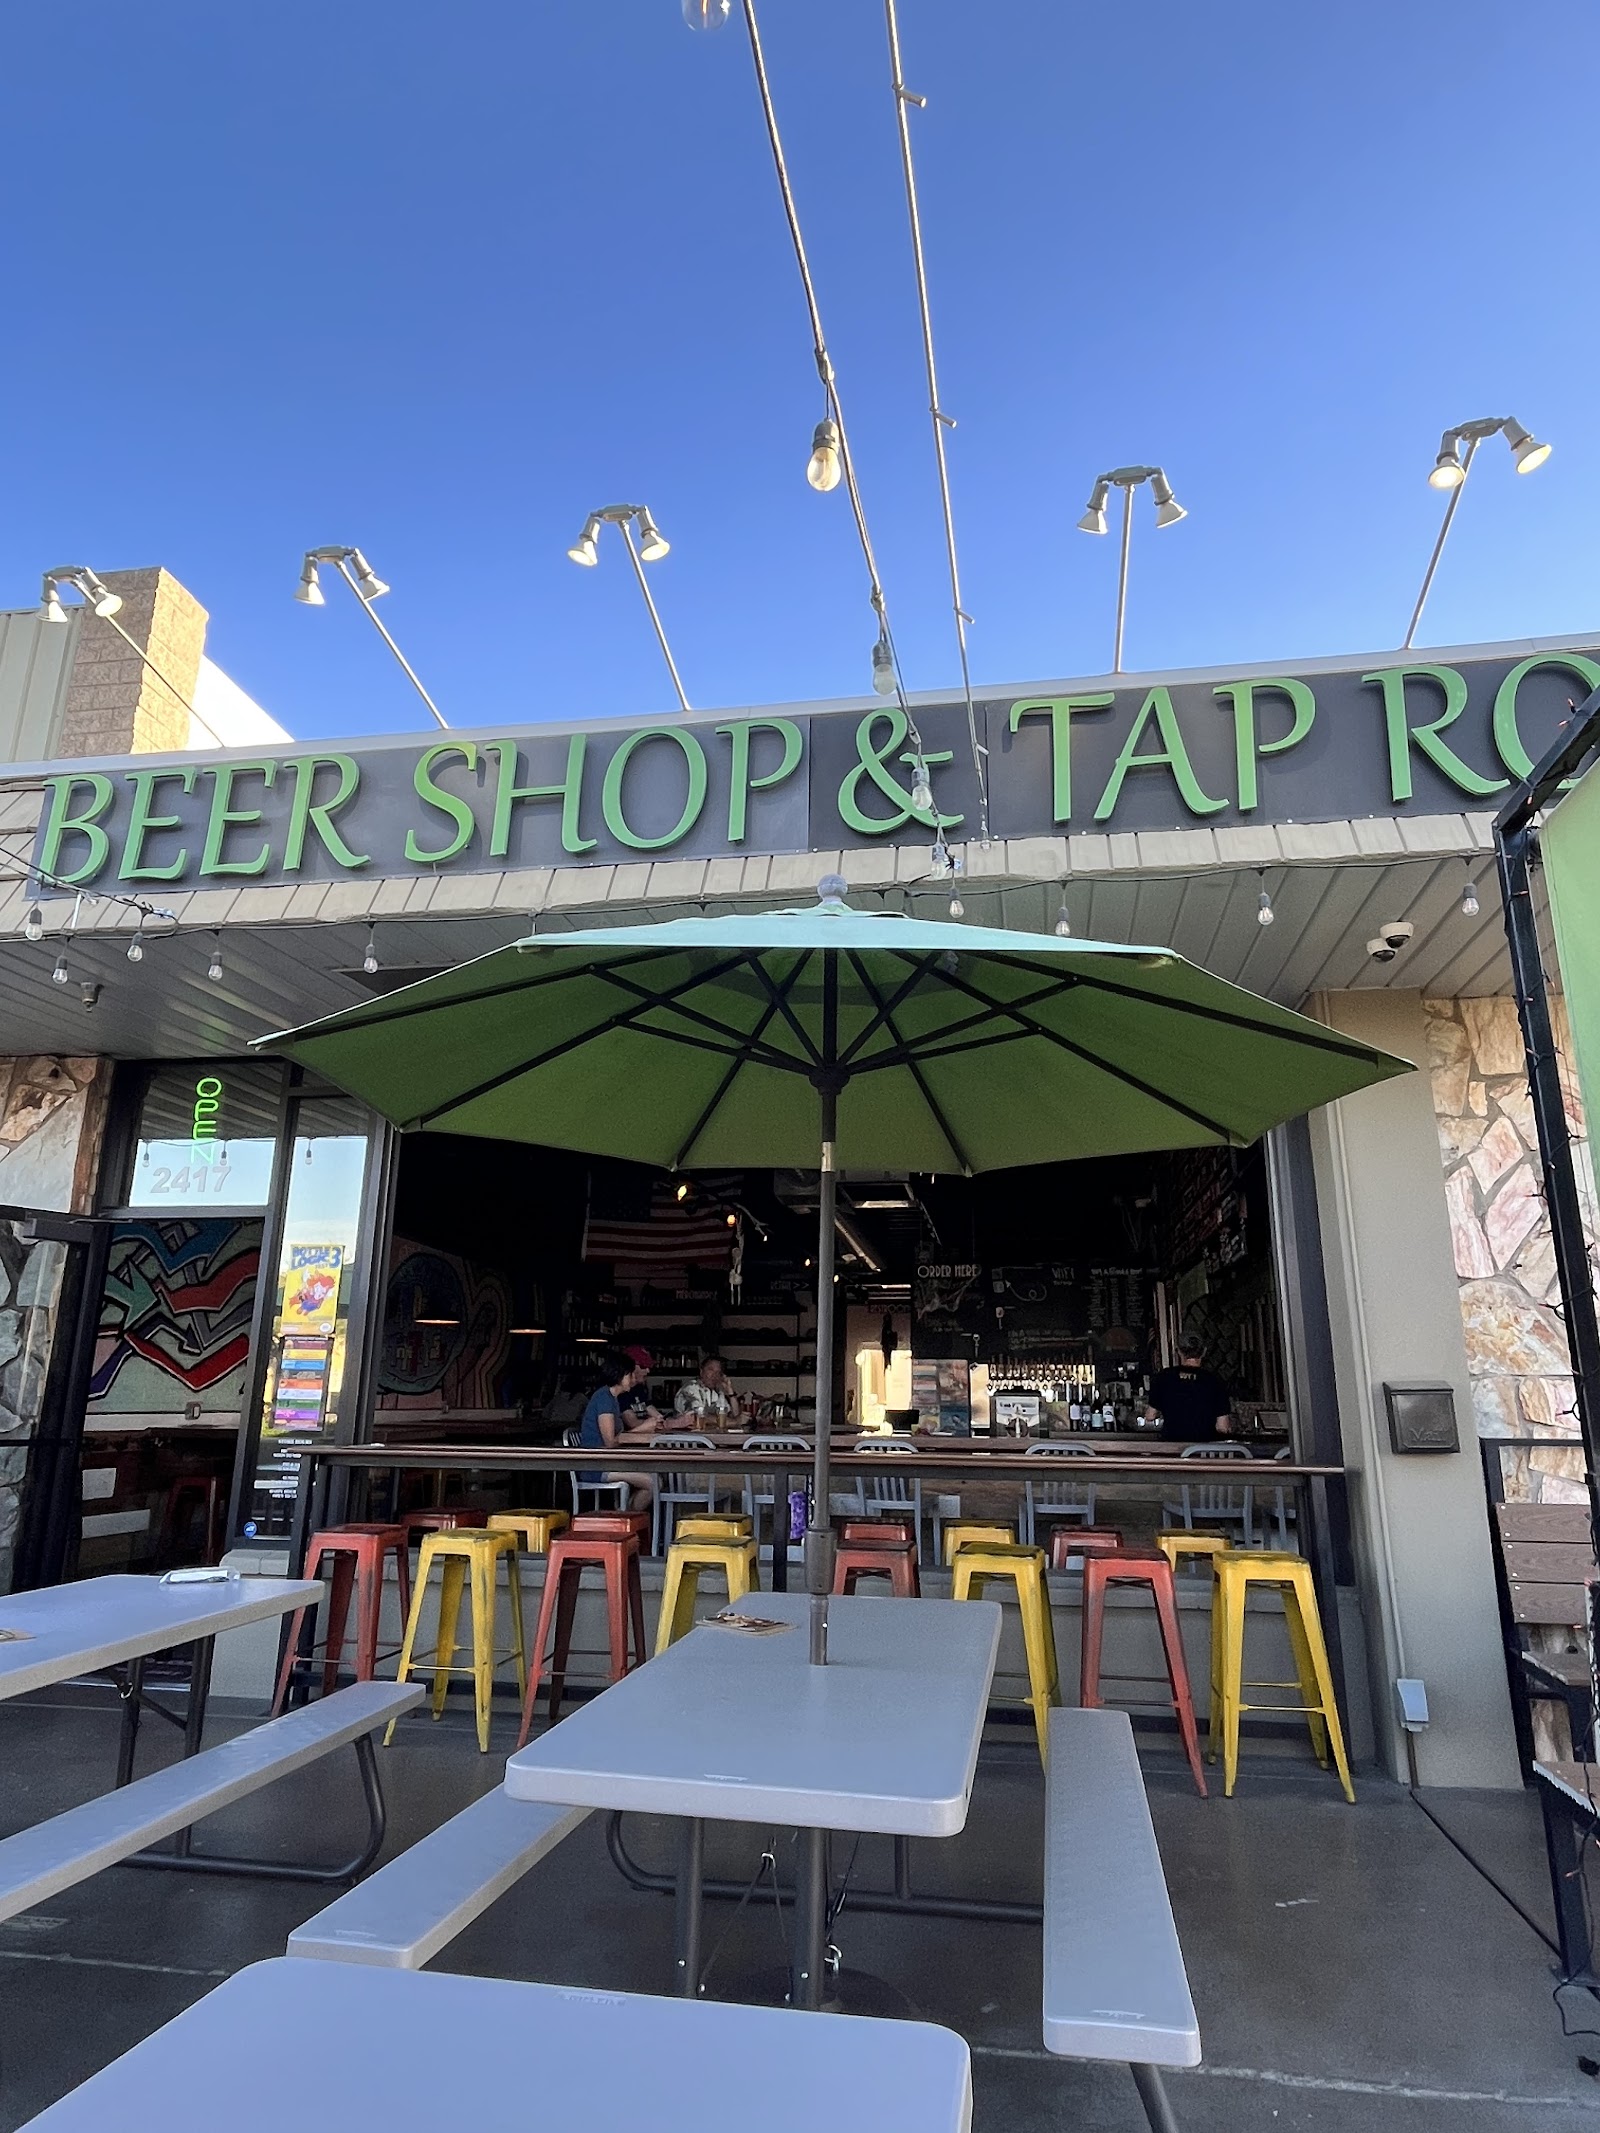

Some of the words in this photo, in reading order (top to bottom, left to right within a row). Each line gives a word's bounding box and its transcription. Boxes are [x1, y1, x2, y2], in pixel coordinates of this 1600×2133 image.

[38, 754, 371, 886] BEER
[405, 717, 803, 862] SHOP
[837, 707, 964, 834] &
[1009, 677, 1316, 822] TAP
[190, 1077, 222, 1164] OPEN
[150, 1166, 232, 1193] 2417
[291, 1254, 328, 1270] LOGIC
[329, 1247, 341, 1268] 3
[917, 1264, 951, 1278] ORDER
[954, 1264, 978, 1278] HERE
